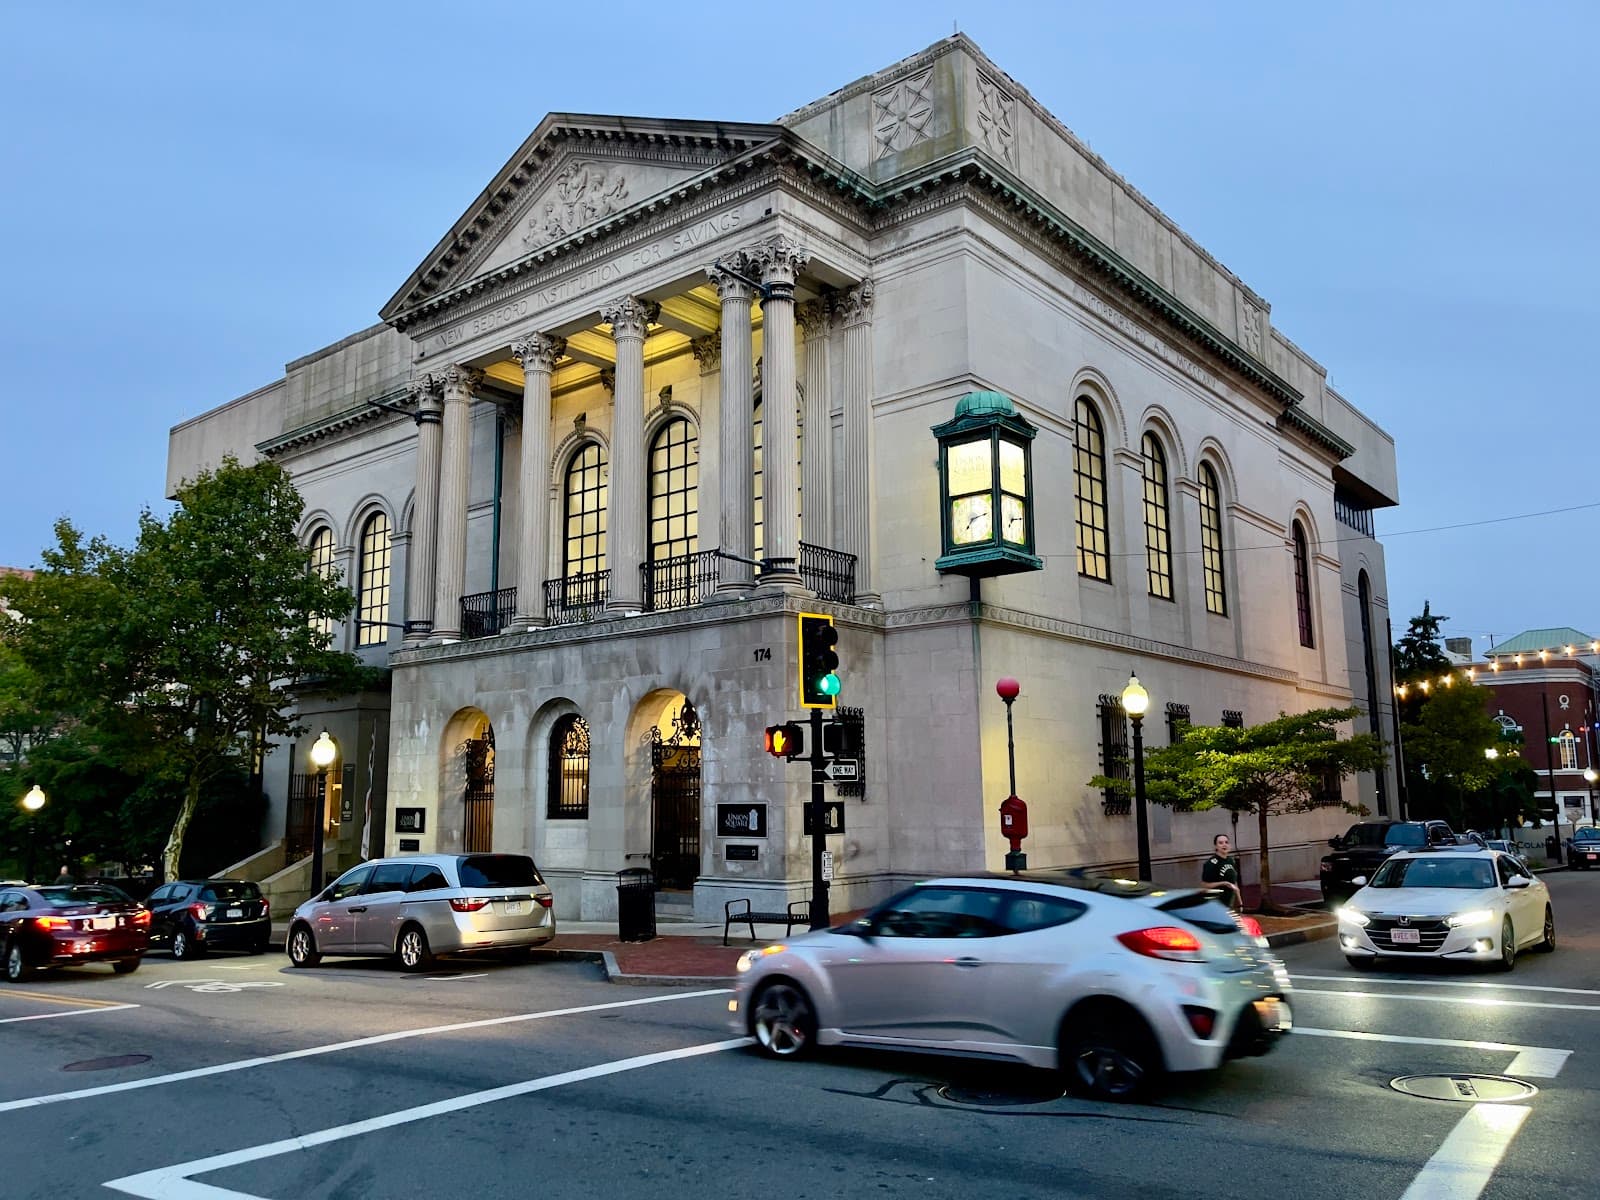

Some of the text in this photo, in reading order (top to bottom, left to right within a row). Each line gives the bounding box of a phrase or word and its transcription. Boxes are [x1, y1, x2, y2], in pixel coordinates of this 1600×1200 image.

[435, 209, 741, 347] NEW BEDFORD INSTITUTION FOR SAVINGS
[753, 648, 771, 662] 174
[832, 766, 854, 775] ONE WAY
[727, 813, 749, 821] UNION
